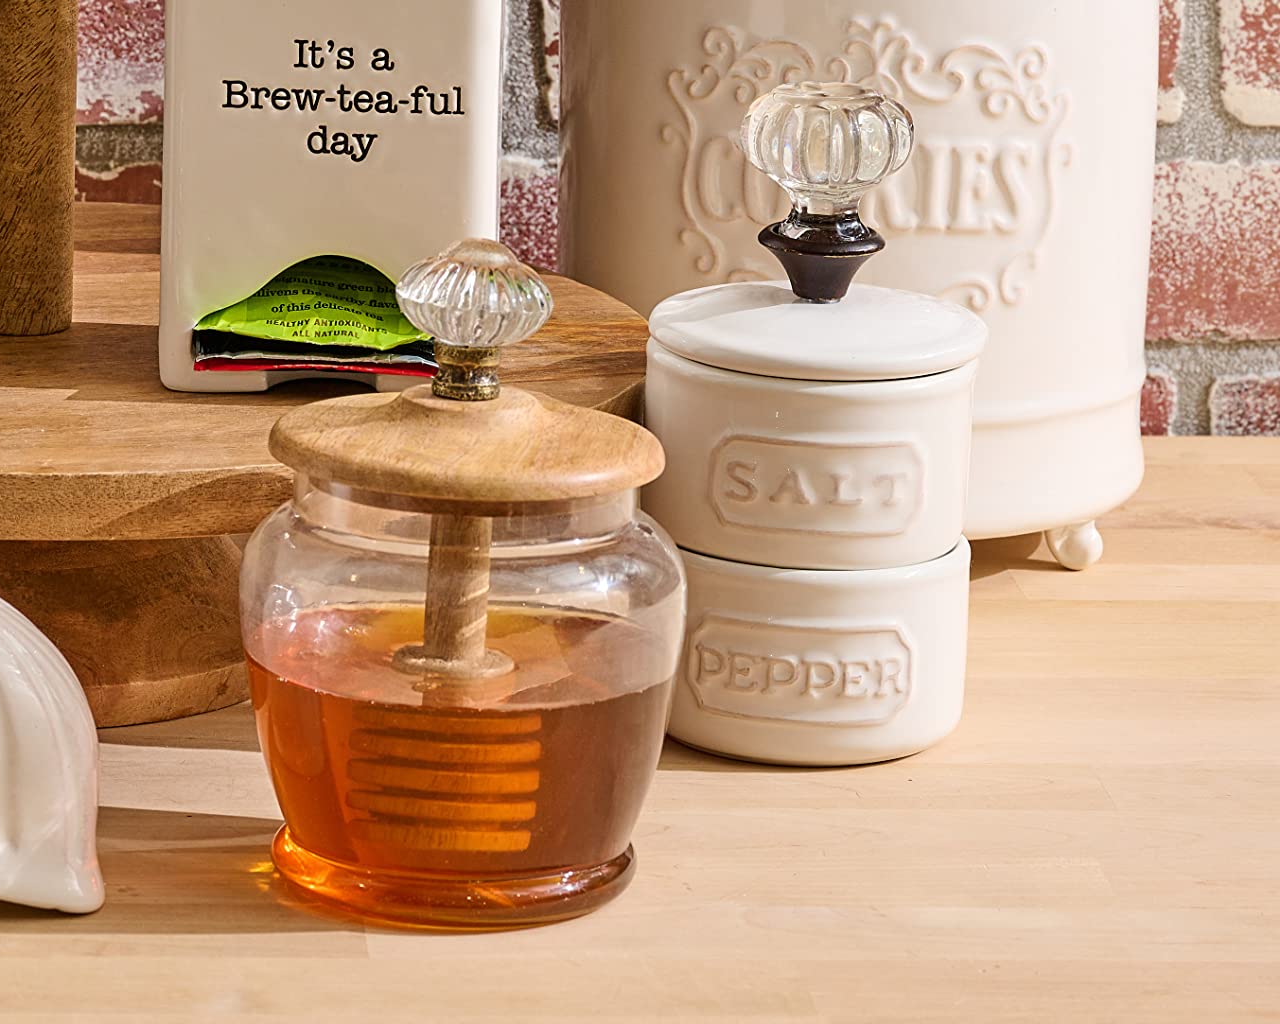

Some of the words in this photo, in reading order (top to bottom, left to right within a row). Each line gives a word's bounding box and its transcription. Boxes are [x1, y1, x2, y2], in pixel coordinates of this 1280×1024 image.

[293, 39, 355, 71] It's
[370, 47, 395, 72] a
[221, 79, 466, 116] Brew-tea-ful
[306, 125, 379, 163] day
[301, 288, 322, 296] the
[368, 299, 399, 309] flavo
[338, 282, 374, 293] green
[271, 303, 285, 313] of
[287, 302, 311, 312] this
[314, 301, 362, 315] delicate
[365, 311, 385, 322] tea
[265, 319, 311, 328] HEALTHY
[314, 319, 388, 335] ANTIOXIDANTS
[292, 330, 310, 338] ALL
[314, 330, 360, 339] NATURAL
[724, 460, 908, 507] SALT
[695, 643, 905, 699] PEPPER
